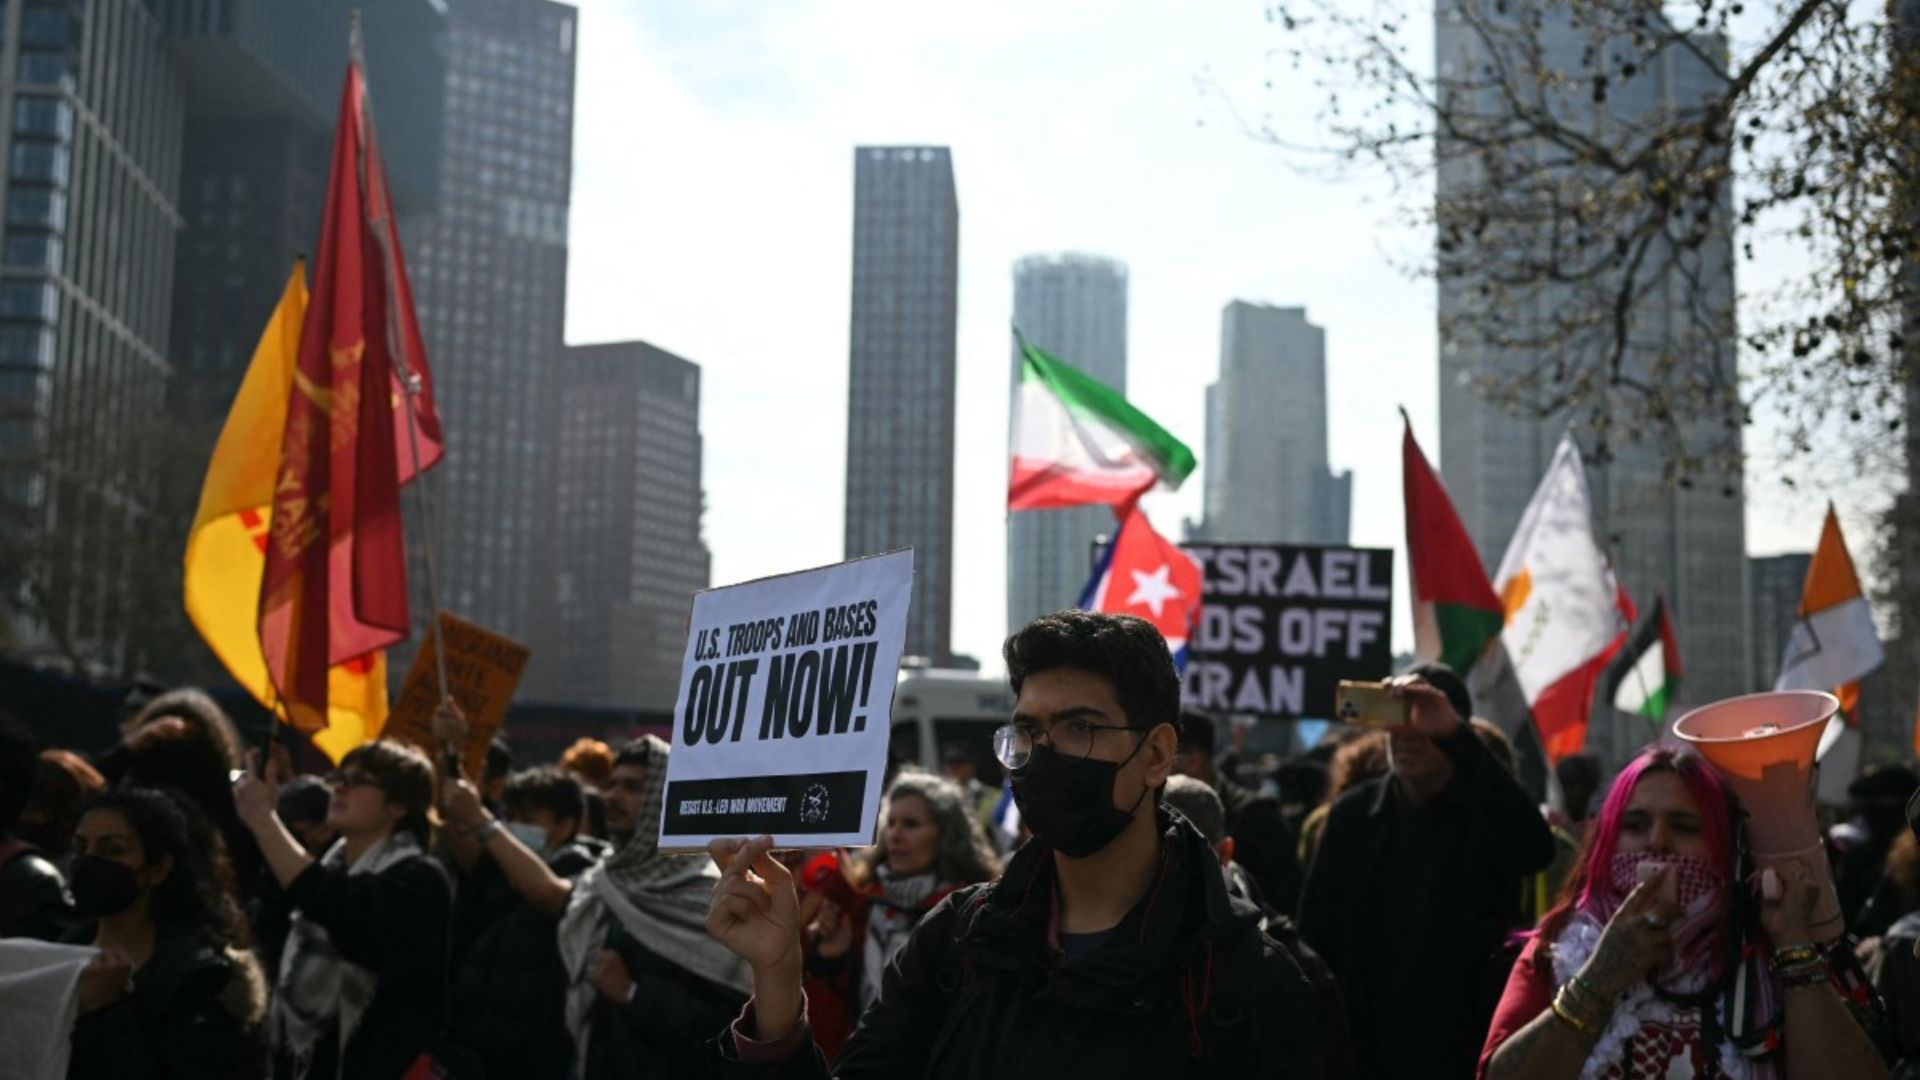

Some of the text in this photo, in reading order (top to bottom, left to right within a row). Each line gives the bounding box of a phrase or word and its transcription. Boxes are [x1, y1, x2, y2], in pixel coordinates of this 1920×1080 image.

[695, 600, 877, 662] U.S. TROOPS AND BASES
[1192, 604, 1383, 658] DS OFF
[683, 641, 878, 746] OUT NOW!
[680, 800, 701, 816] RESIST
[746, 797, 787, 813] MOVEMENT
